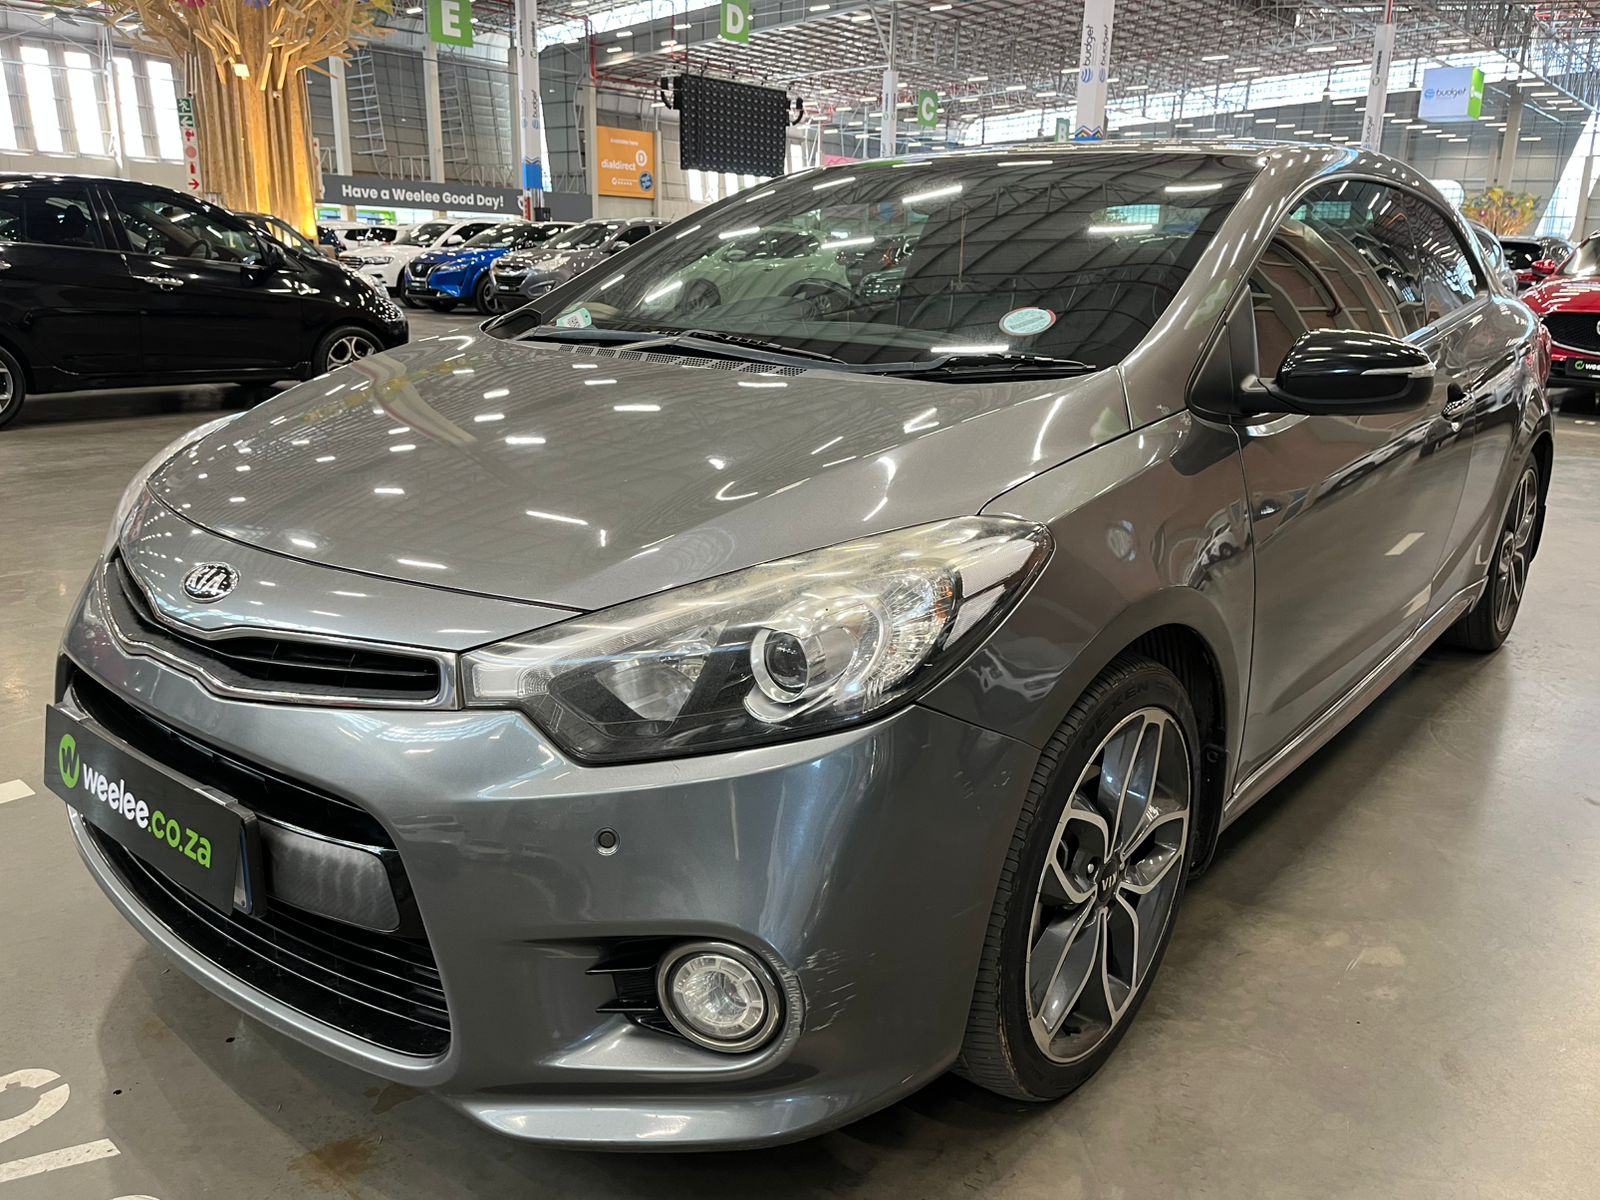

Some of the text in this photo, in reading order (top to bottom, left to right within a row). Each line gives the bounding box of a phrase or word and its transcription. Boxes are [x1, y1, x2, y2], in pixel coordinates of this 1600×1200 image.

[441, 0, 462, 38] E
[727, 3, 744, 34] D
[1083, 24, 1097, 67] budget
[1436, 87, 1467, 98] budget
[922, 96, 936, 121] C
[601, 158, 636, 171] dialdirect
[341, 184, 504, 210] Have a Weelee Good Day!
[83, 762, 212, 869] weelee.co.za
